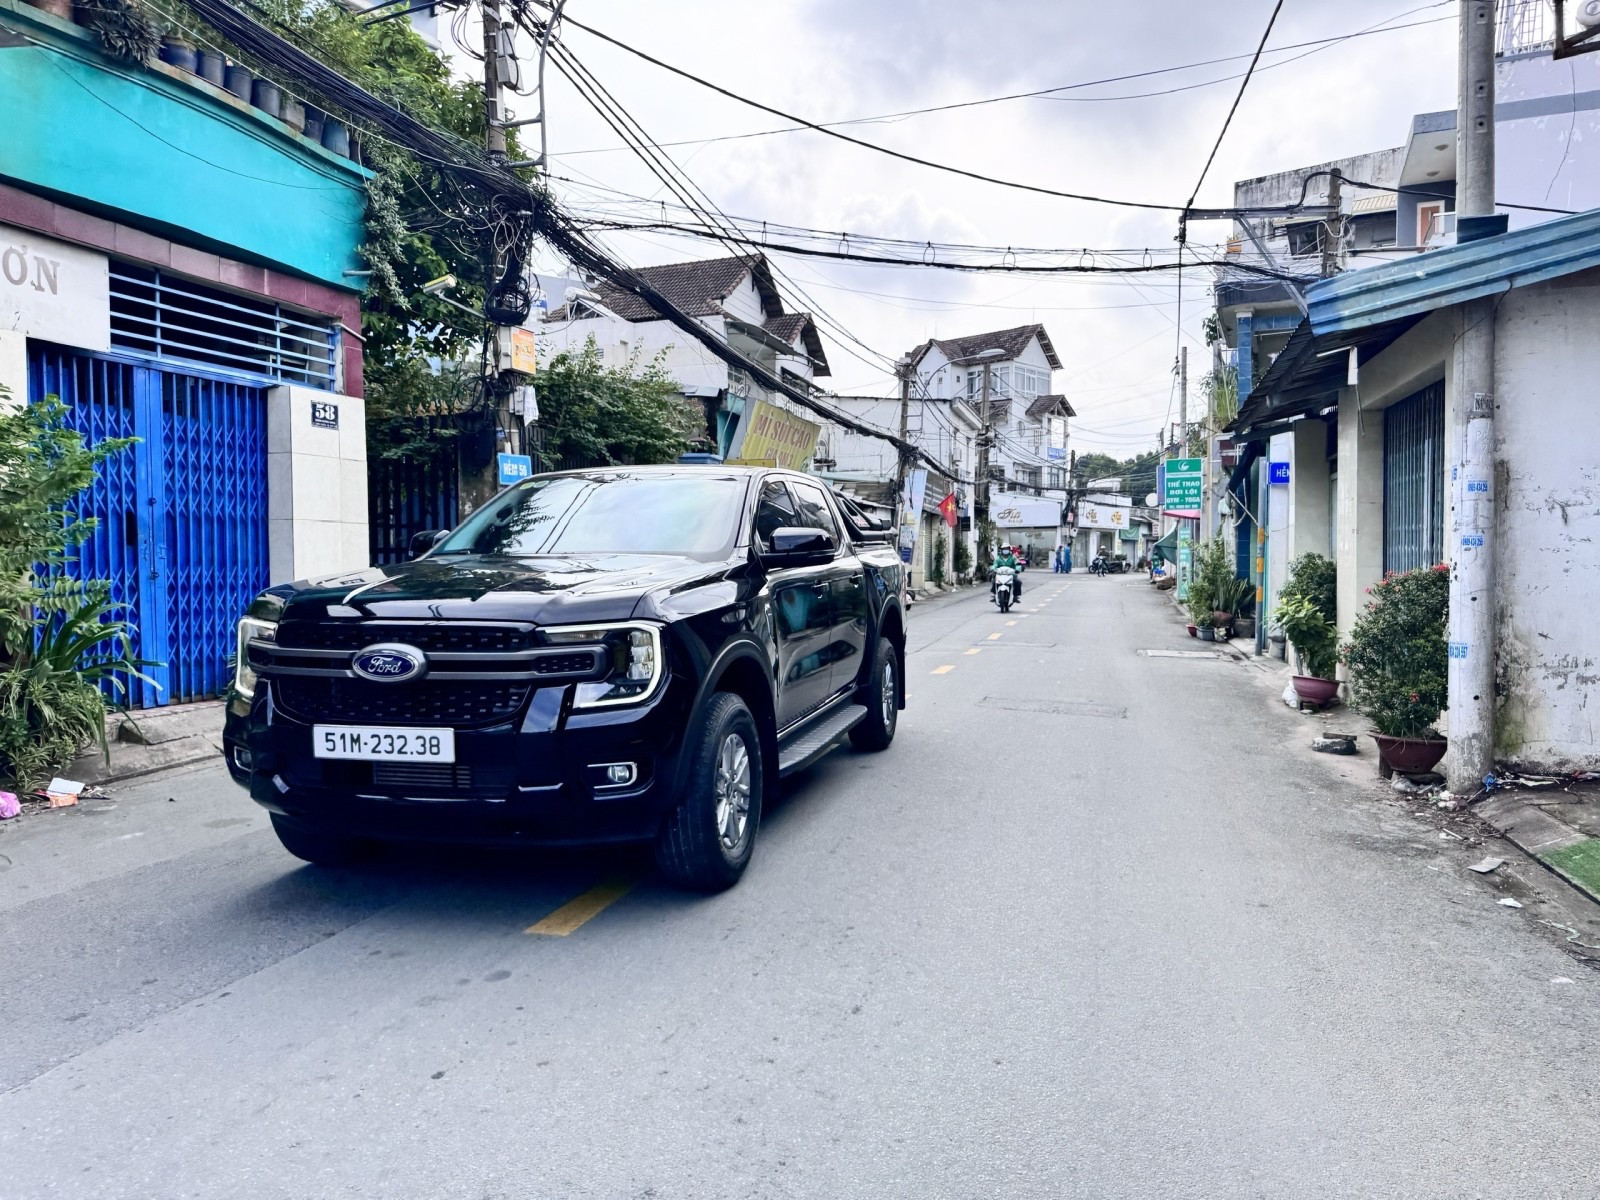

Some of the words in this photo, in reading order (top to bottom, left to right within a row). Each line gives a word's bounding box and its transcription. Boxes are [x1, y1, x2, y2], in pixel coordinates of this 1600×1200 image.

[315, 401, 336, 421] 58
[1181, 480, 1200, 488] THAO
[367, 655, 402, 674] Ford
[324, 731, 442, 757] 51M-232.38
